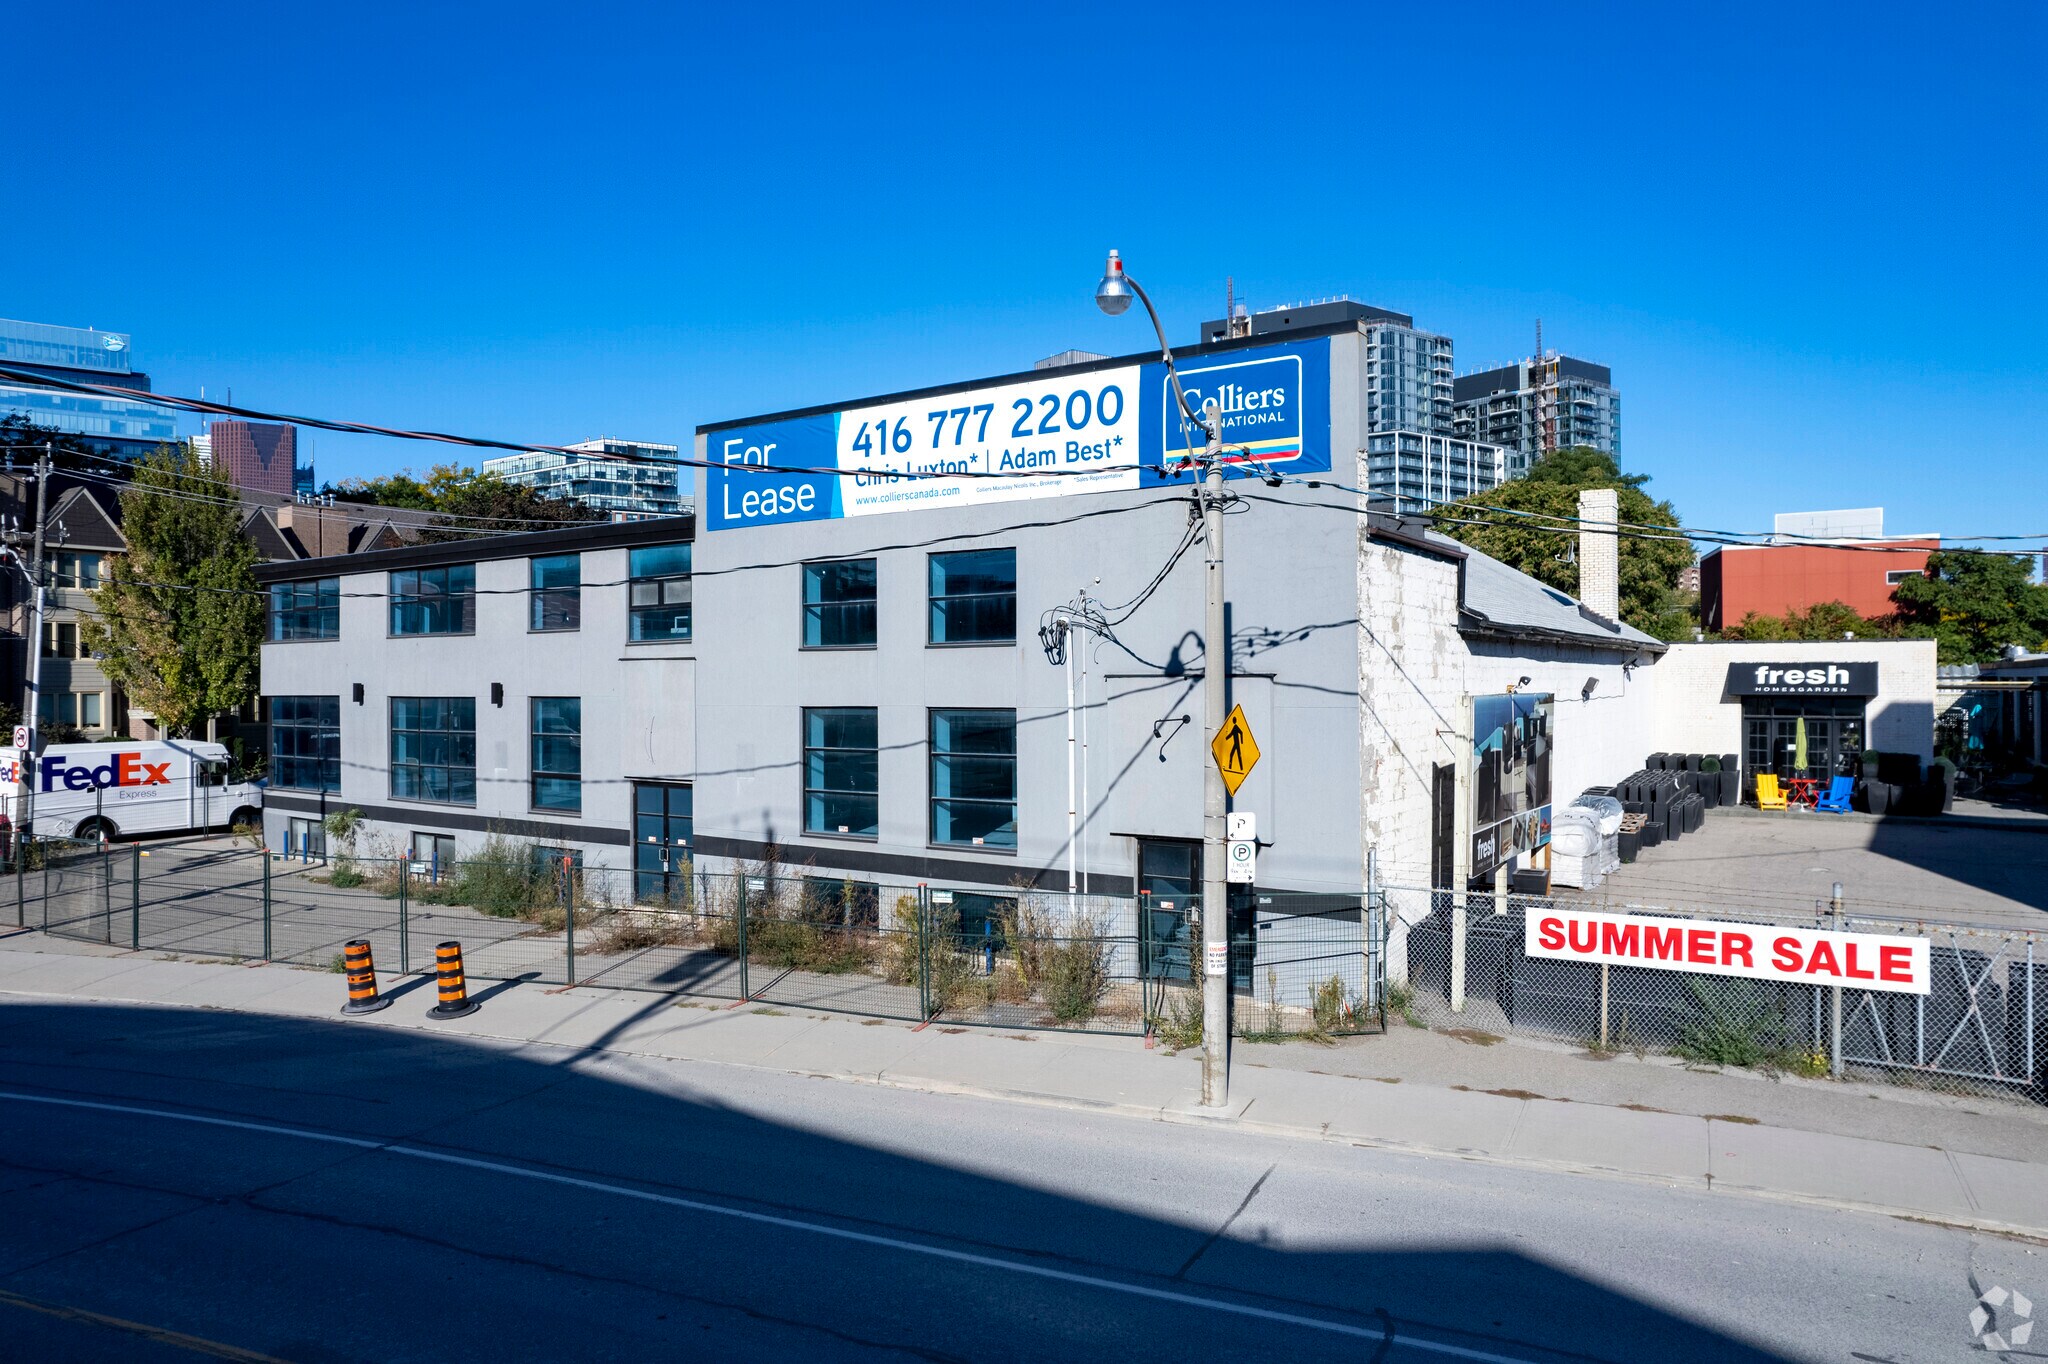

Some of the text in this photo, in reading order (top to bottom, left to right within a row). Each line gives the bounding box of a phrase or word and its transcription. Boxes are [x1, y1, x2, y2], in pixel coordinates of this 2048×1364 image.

[1181, 383, 1285, 418] Colliers
[852, 384, 1124, 458] 416 777 2200
[1179, 411, 1285, 433] INTNATIONAL
[724, 438, 816, 520] For Lease
[855, 463, 899, 487] Chris
[999, 446, 1056, 471] Adam
[1089, 473, 1124, 482] Representative
[855, 486, 961, 505] www.collierscanada.com
[1754, 665, 1850, 685] fresh
[0, 761, 20, 783] edE
[42, 752, 172, 792] FedEx
[119, 789, 157, 799] Express
[1538, 917, 1914, 983] SUMMER SALE
